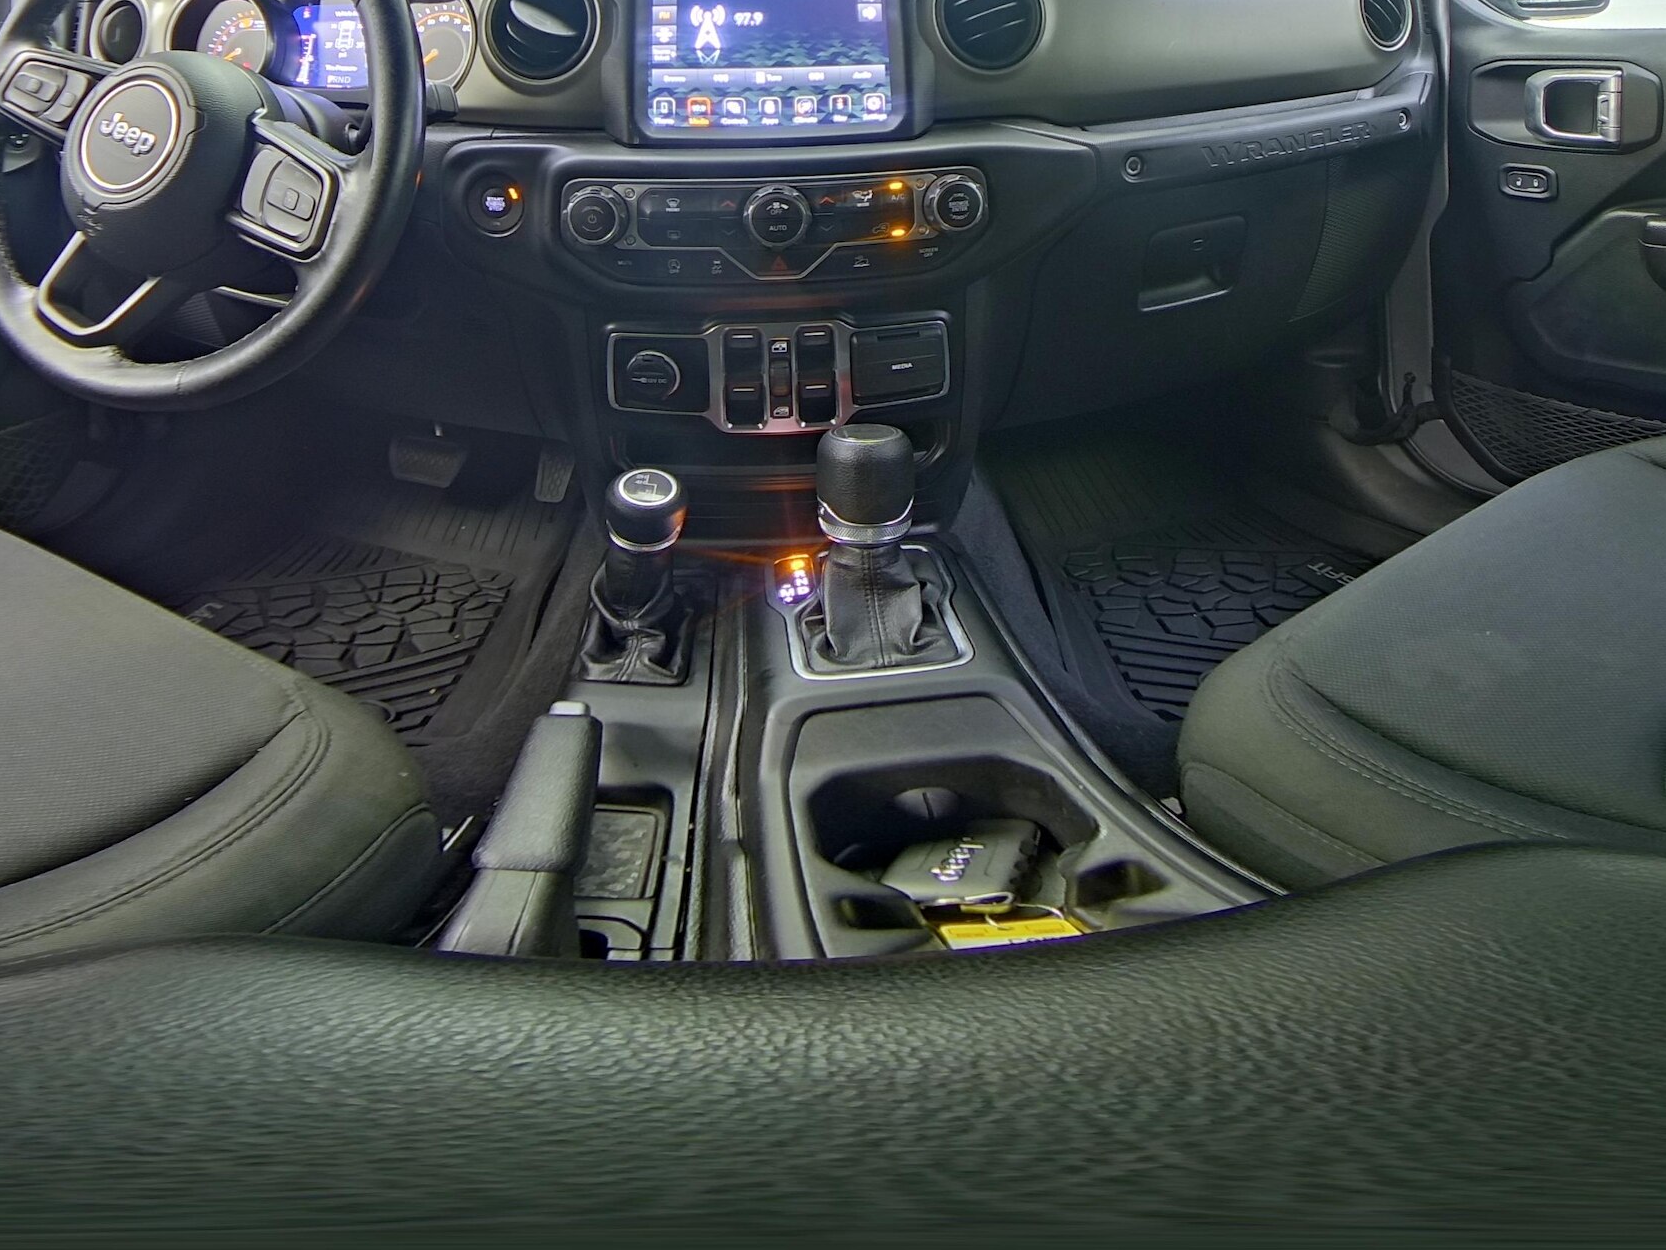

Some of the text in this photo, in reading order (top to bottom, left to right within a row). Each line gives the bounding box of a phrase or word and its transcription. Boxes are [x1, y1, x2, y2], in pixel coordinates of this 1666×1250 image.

[733, 11, 764, 27] 97.9
[99, 111, 156, 157] Jeep
[1201, 121, 1371, 168] WRANGLER
[891, 362, 914, 371] MEDIA
[795, 577, 809, 586] N
[779, 587, 795, 598] M
